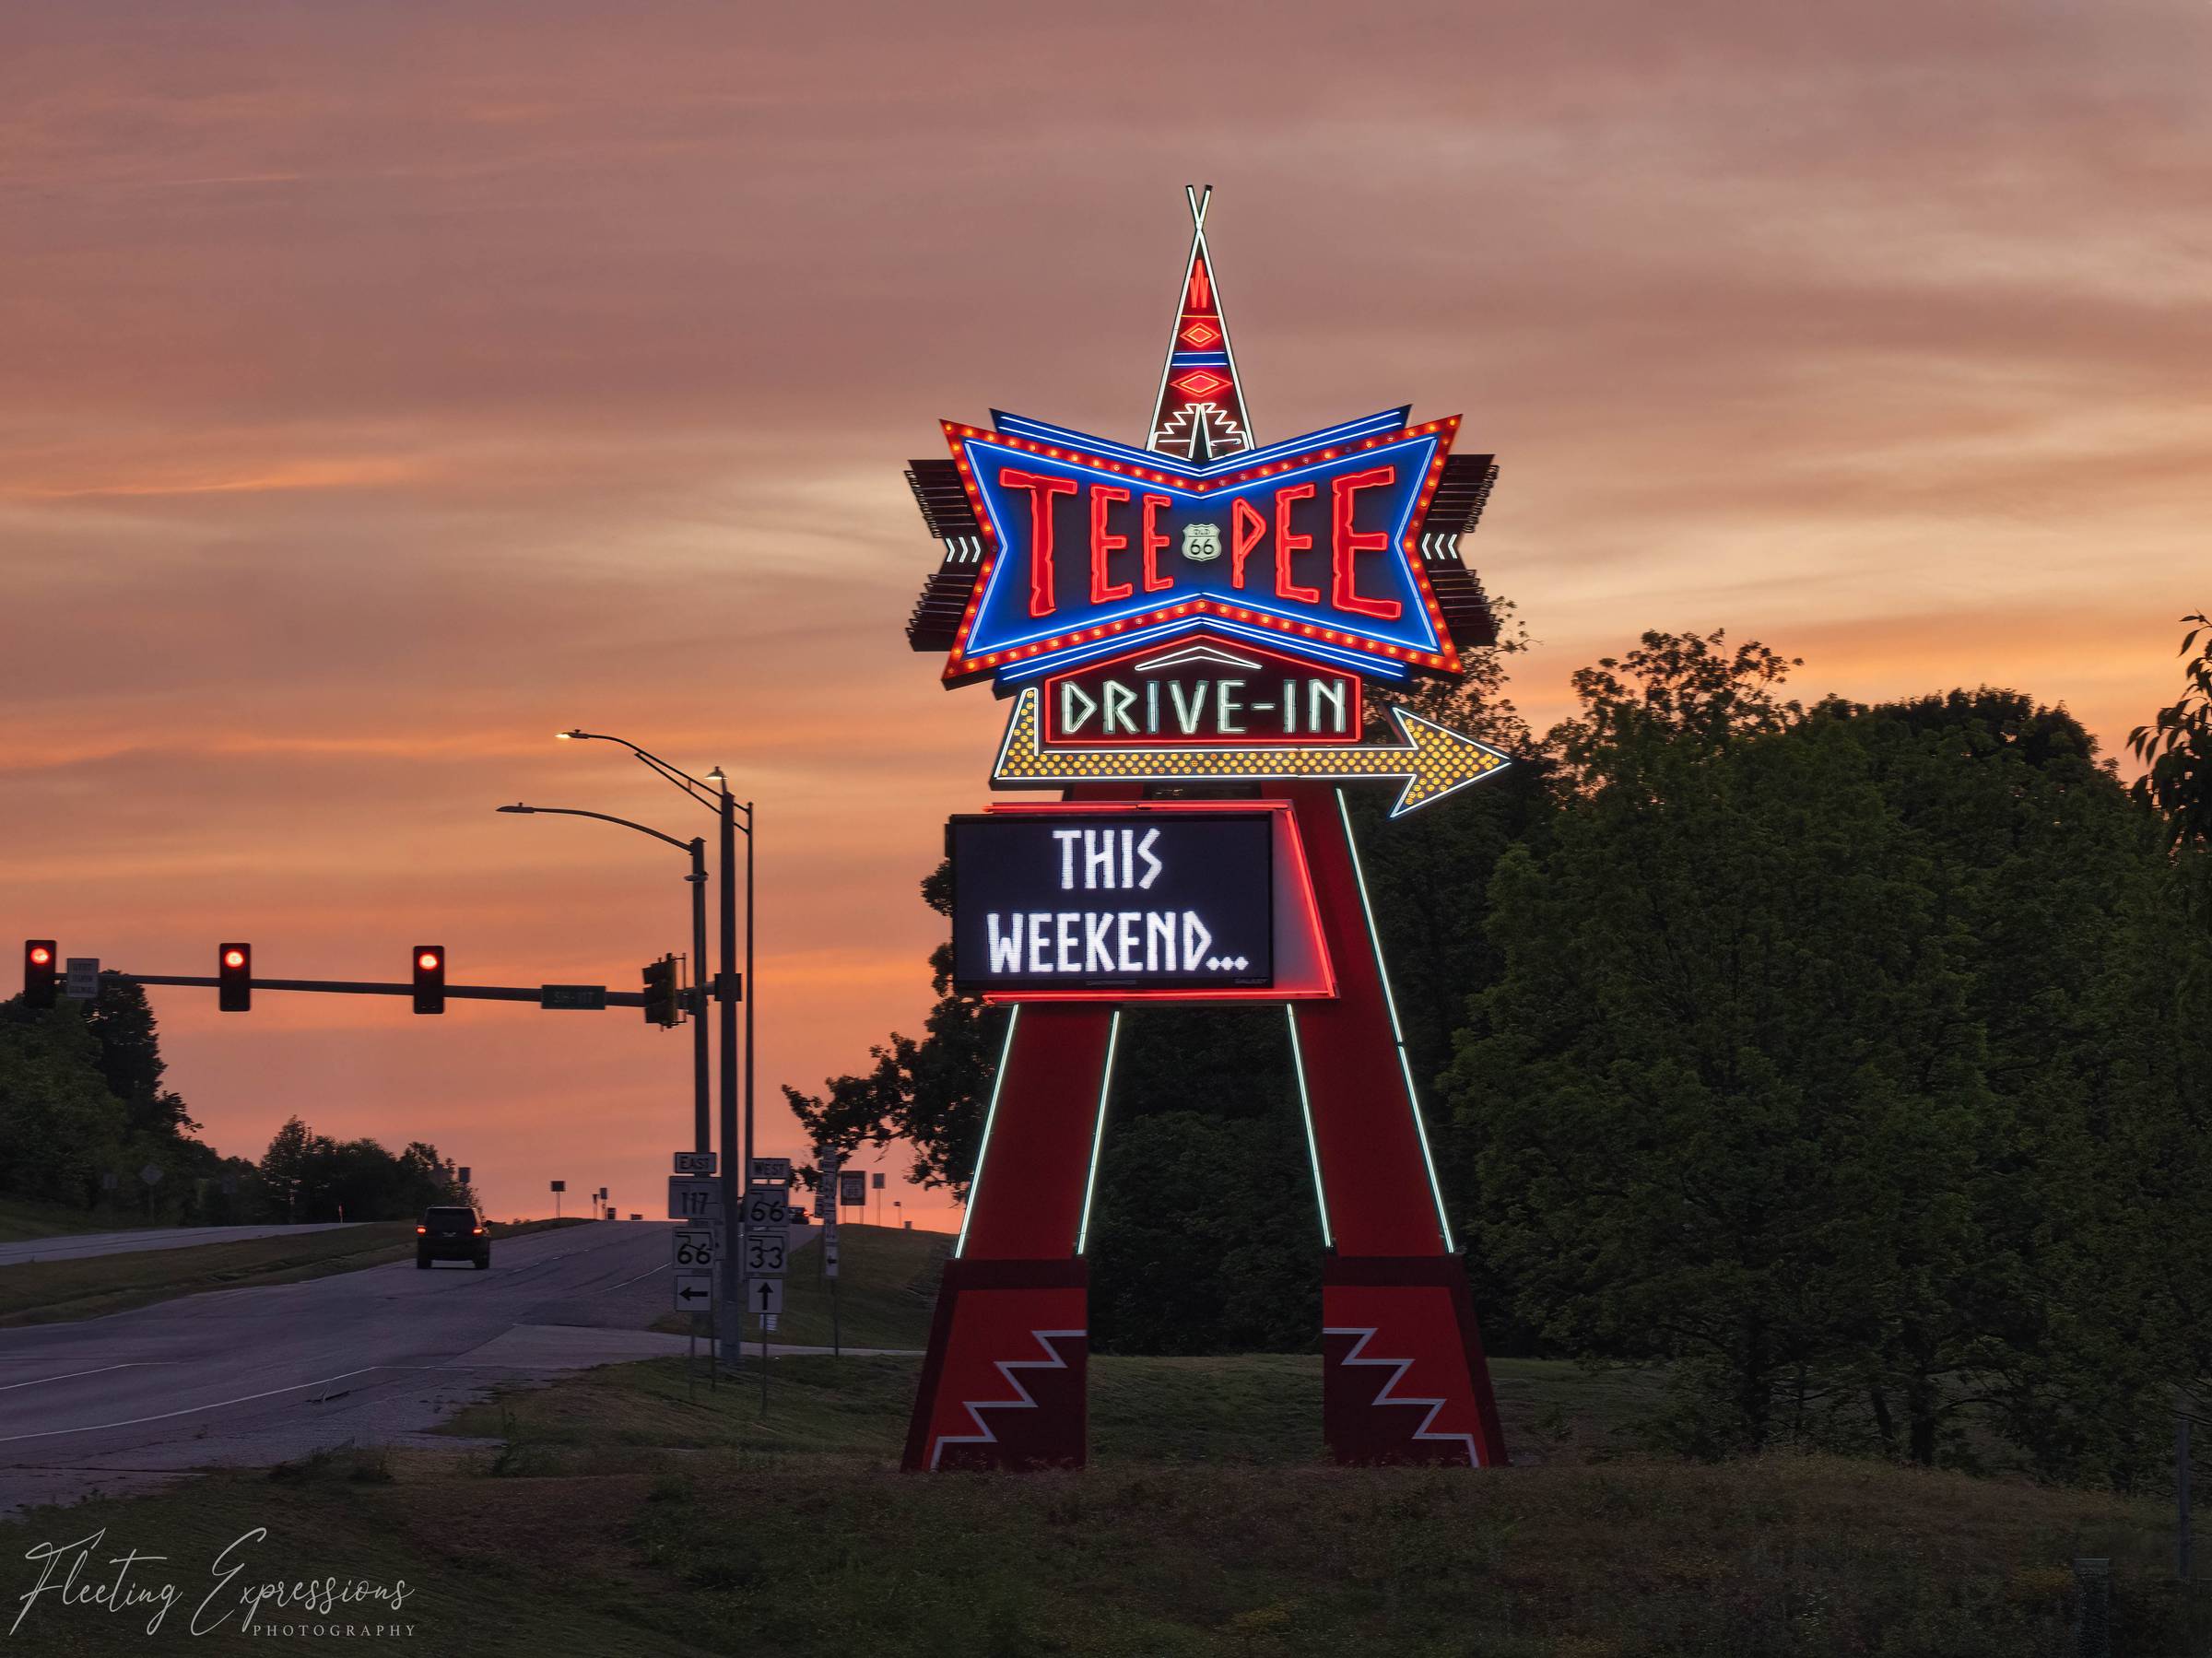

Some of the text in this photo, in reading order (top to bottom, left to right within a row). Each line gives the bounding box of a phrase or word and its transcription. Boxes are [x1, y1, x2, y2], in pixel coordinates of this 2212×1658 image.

[1000, 465, 1402, 619] TEE PEE
[1190, 539, 1214, 555] 66
[1061, 679, 1346, 735] DRIVE-IN
[1053, 827, 1163, 890] THIS
[986, 911, 1250, 973] WEEKEND...
[679, 1156, 709, 1169] EAST
[753, 1162, 785, 1175] WEST
[682, 1193, 708, 1215] 117
[750, 1201, 784, 1221] 66
[677, 1244, 711, 1264] 66
[750, 1246, 782, 1268] 33
